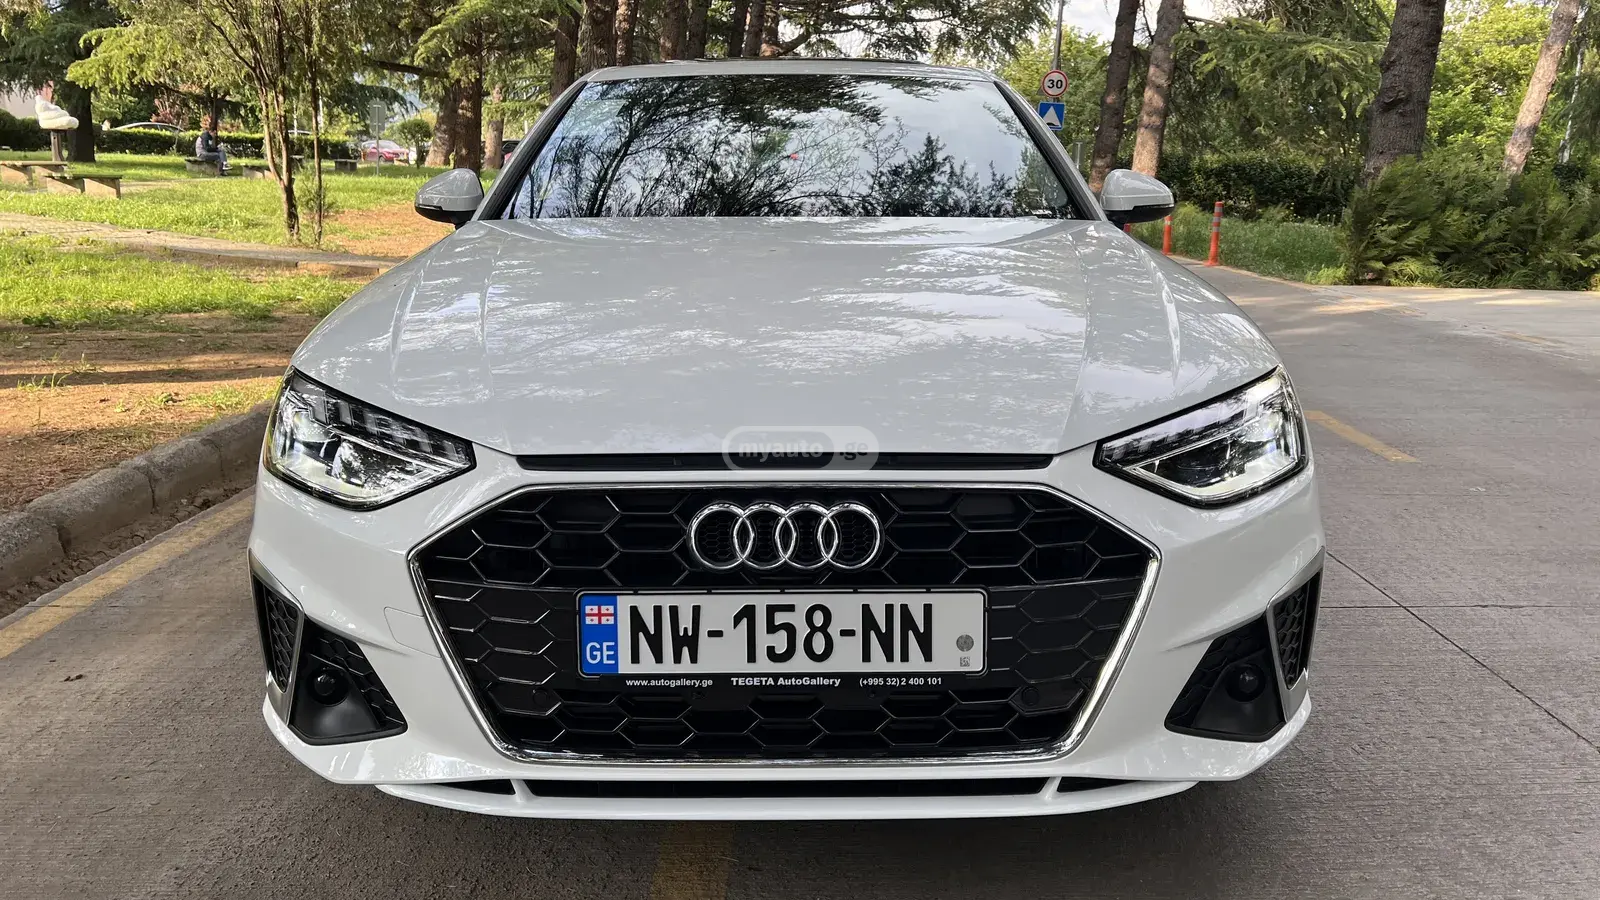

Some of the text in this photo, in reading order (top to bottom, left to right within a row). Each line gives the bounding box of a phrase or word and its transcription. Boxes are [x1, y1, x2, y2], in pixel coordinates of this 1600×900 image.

[1047, 79, 1063, 89] 30
[629, 603, 933, 665] NW-158-NN
[586, 642, 615, 665] GE
[625, 678, 713, 688] www.autogallery.ge
[731, 676, 841, 687] TEGETA AutoGallery
[859, 677, 884, 687] (+995
[908, 677, 925, 686] 400
[927, 677, 942, 685] 101
